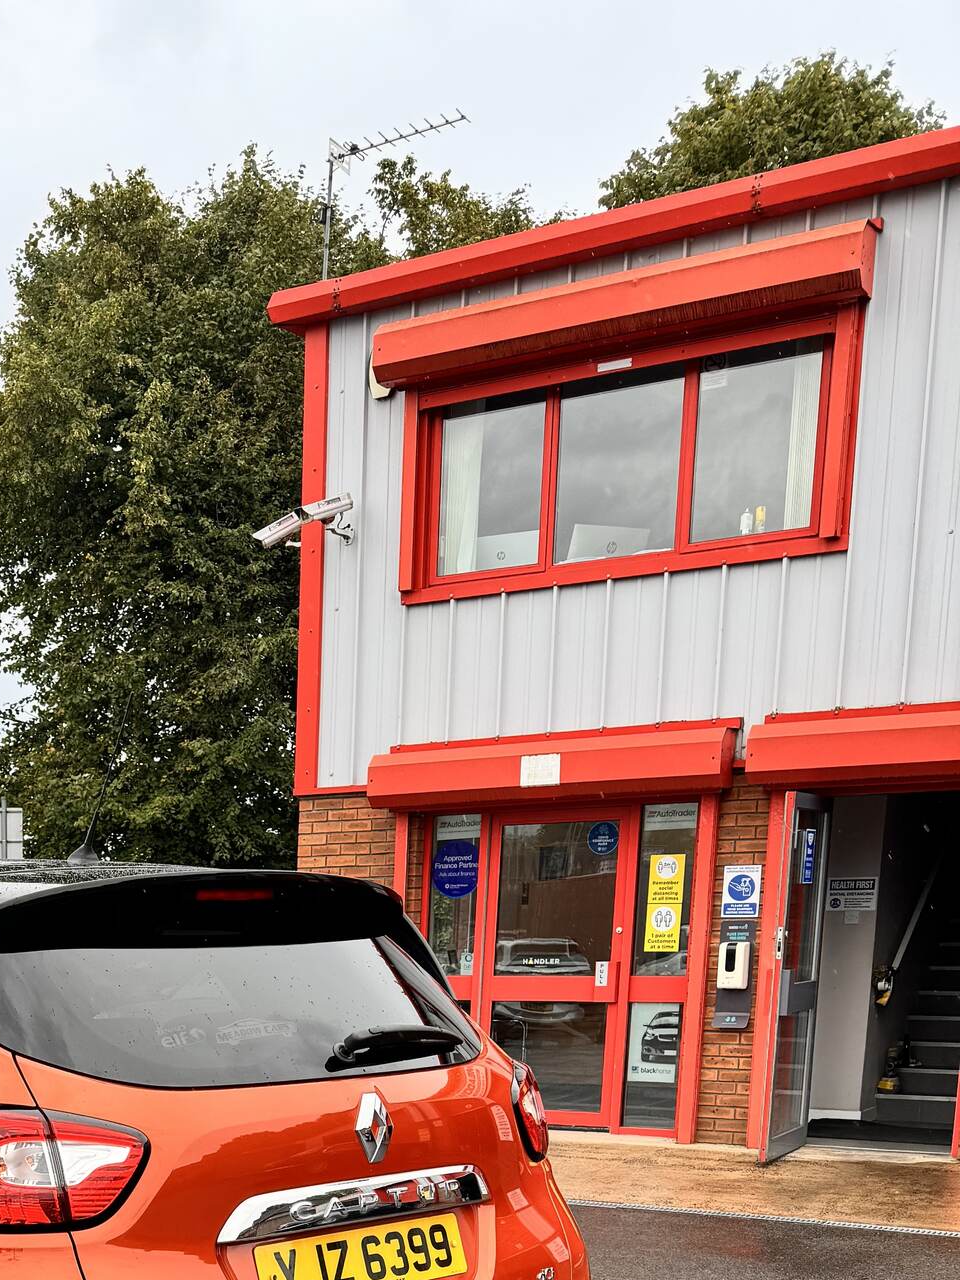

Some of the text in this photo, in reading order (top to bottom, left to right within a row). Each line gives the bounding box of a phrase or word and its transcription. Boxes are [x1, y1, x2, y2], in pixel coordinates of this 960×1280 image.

[655, 809, 696, 818] AutoTrader
[443, 854, 472, 862] Approved
[831, 880, 874, 890] HEALTH FIRST
[160, 1030, 191, 1048] elf
[216, 1025, 262, 1043] MEADOW
[289, 1179, 460, 1223] CAPTUR
